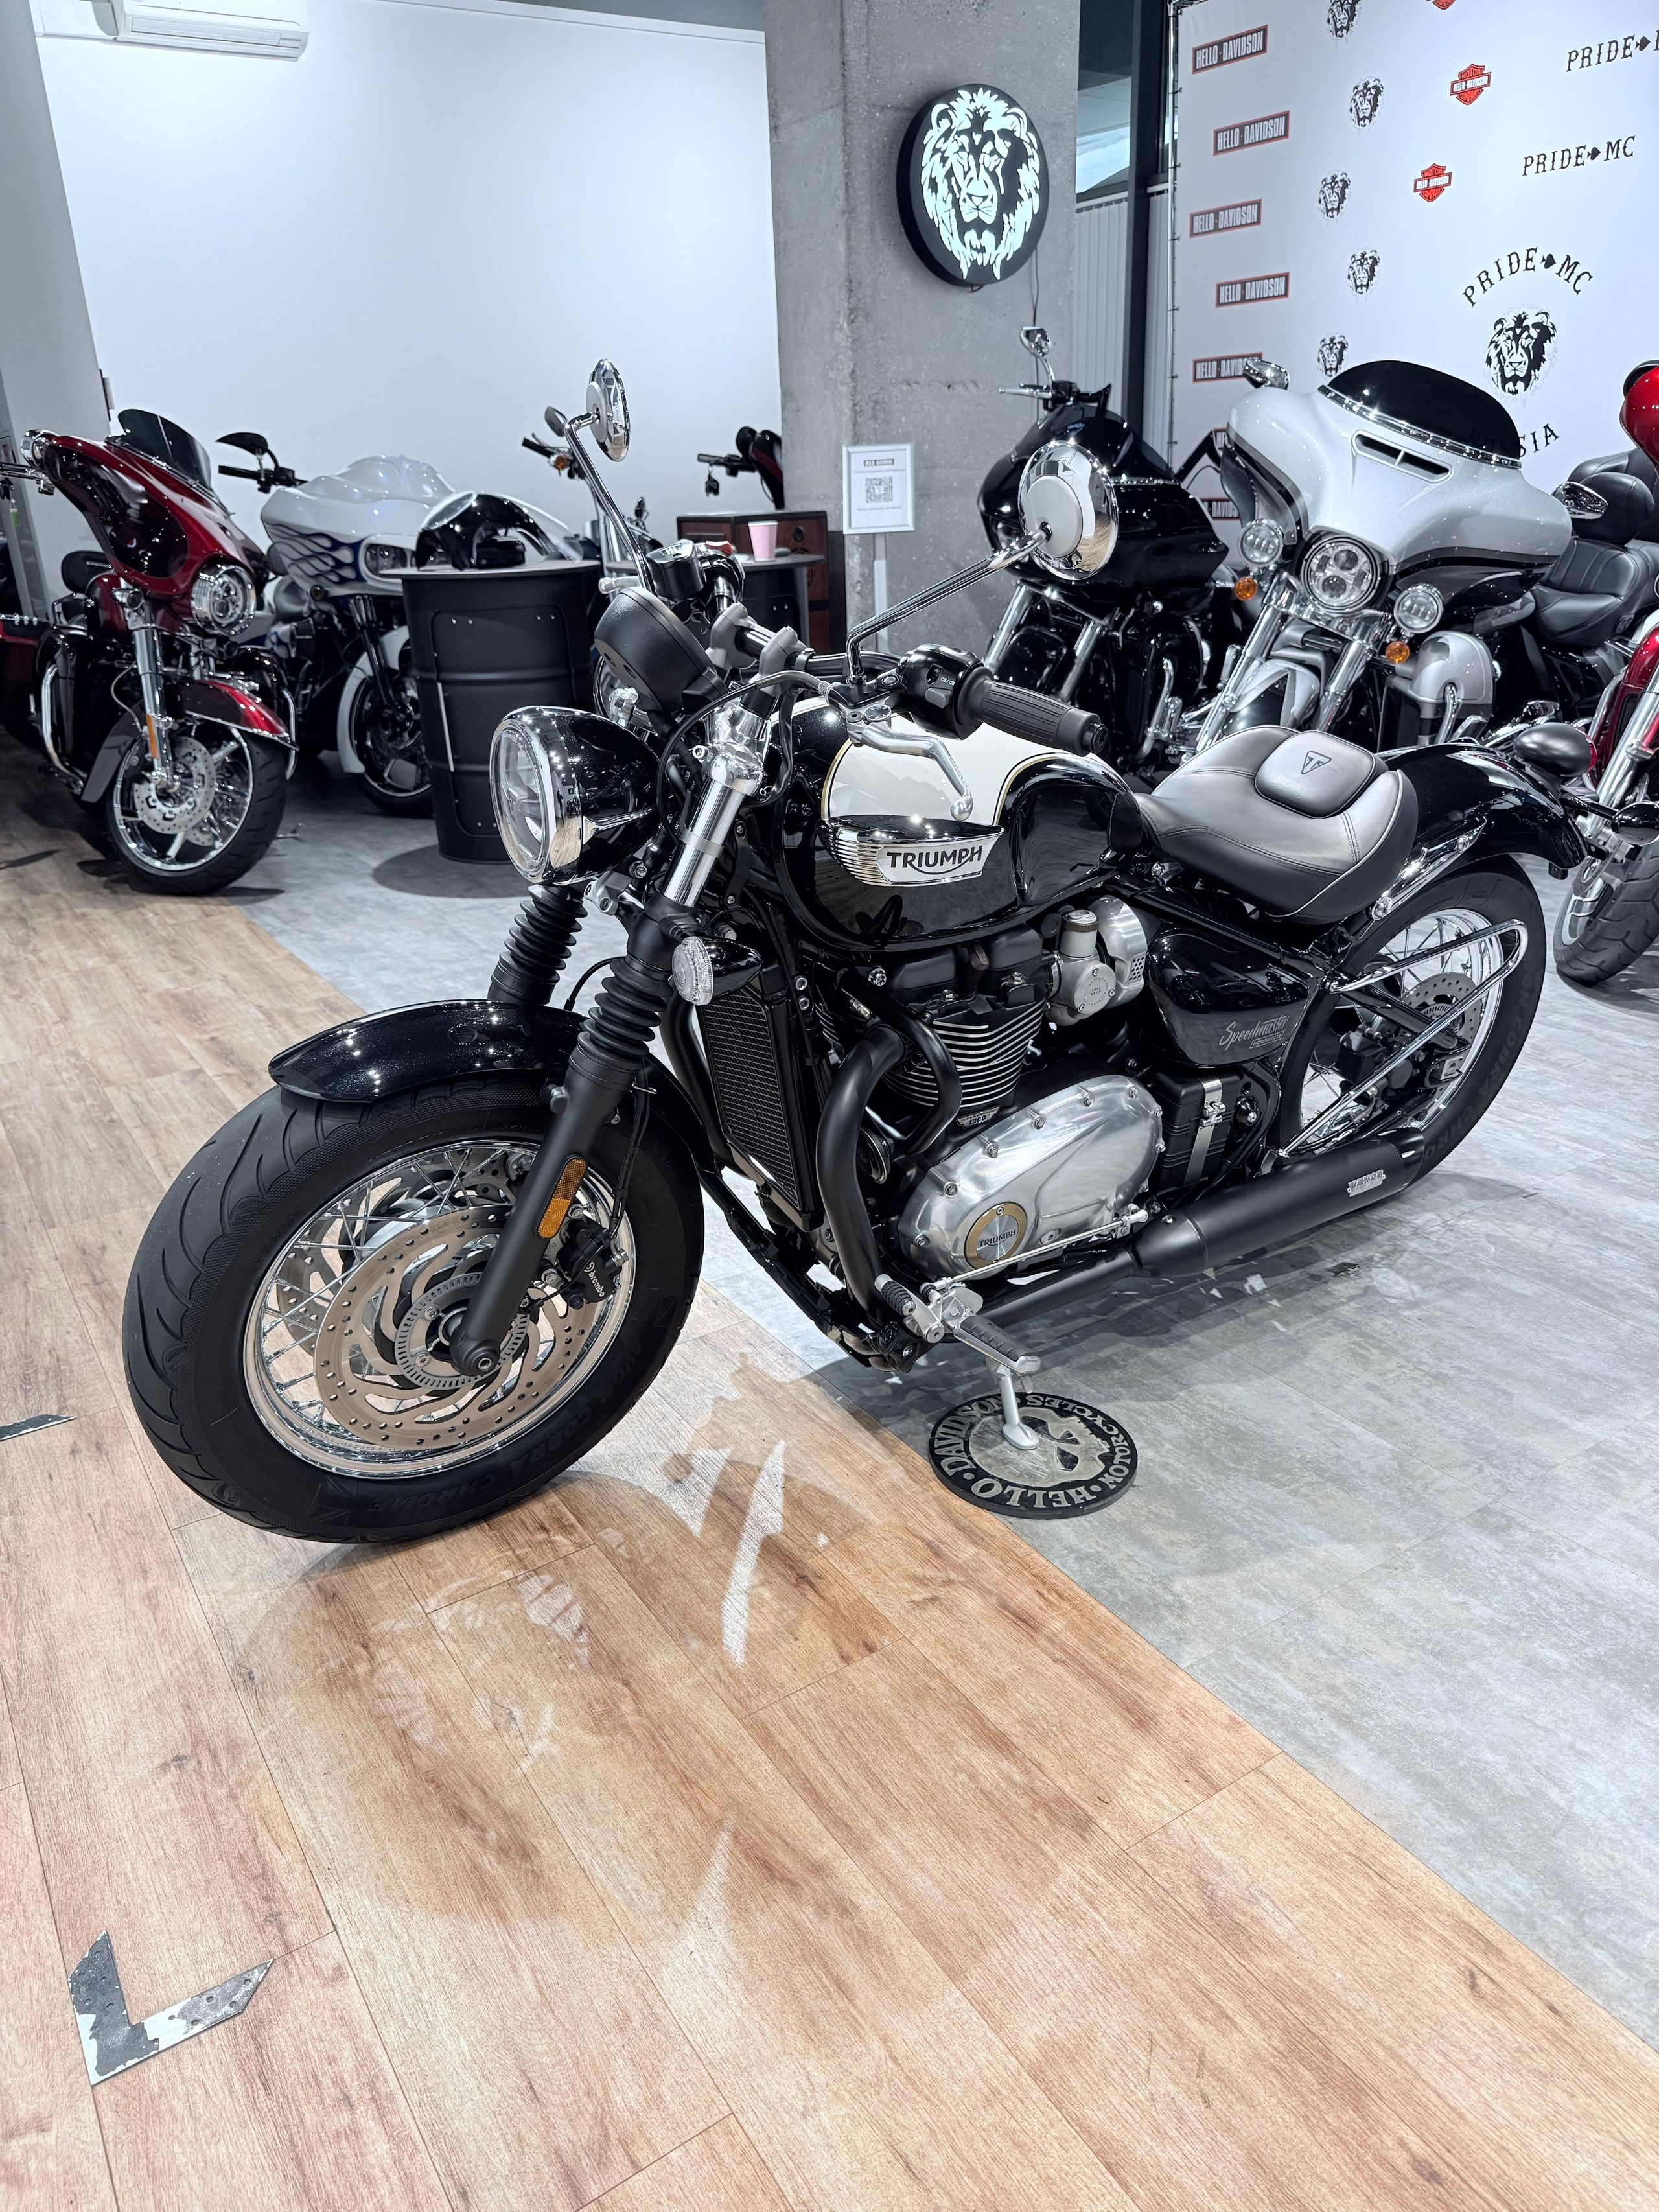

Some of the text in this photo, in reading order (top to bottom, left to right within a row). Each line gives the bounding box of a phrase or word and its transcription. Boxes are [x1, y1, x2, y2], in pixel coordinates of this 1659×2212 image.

[1196, 31, 1264, 69] HELLO DAVIDSON
[1566, 34, 1635, 72] PRIDE
[1461, 68, 1481, 78] MOTOR
[1217, 116, 1285, 151] HELLO DAVIDSON
[1522, 135, 1636, 176] PRIDE MC
[1424, 167, 1443, 177] MOTOR
[1193, 204, 1258, 234] HELLO DAVIDSON
[1220, 276, 1286, 304] HELLO DAVIDSON
[1462, 246, 1594, 308] PRIDE MC
[1196, 360, 1217, 380] HELLO
[886, 845, 983, 875] TRIUMPH
[1219, 1014, 1290, 1051] Speedmaster
[1424, 1105, 1473, 1159] CHRO
[979, 1229, 1016, 1247] TRIUMPH
[588, 1270, 605, 1297] brembo
[934, 1397, 1004, 1476] DAVIDSON
[971, 1478, 1096, 1508] HELLO
